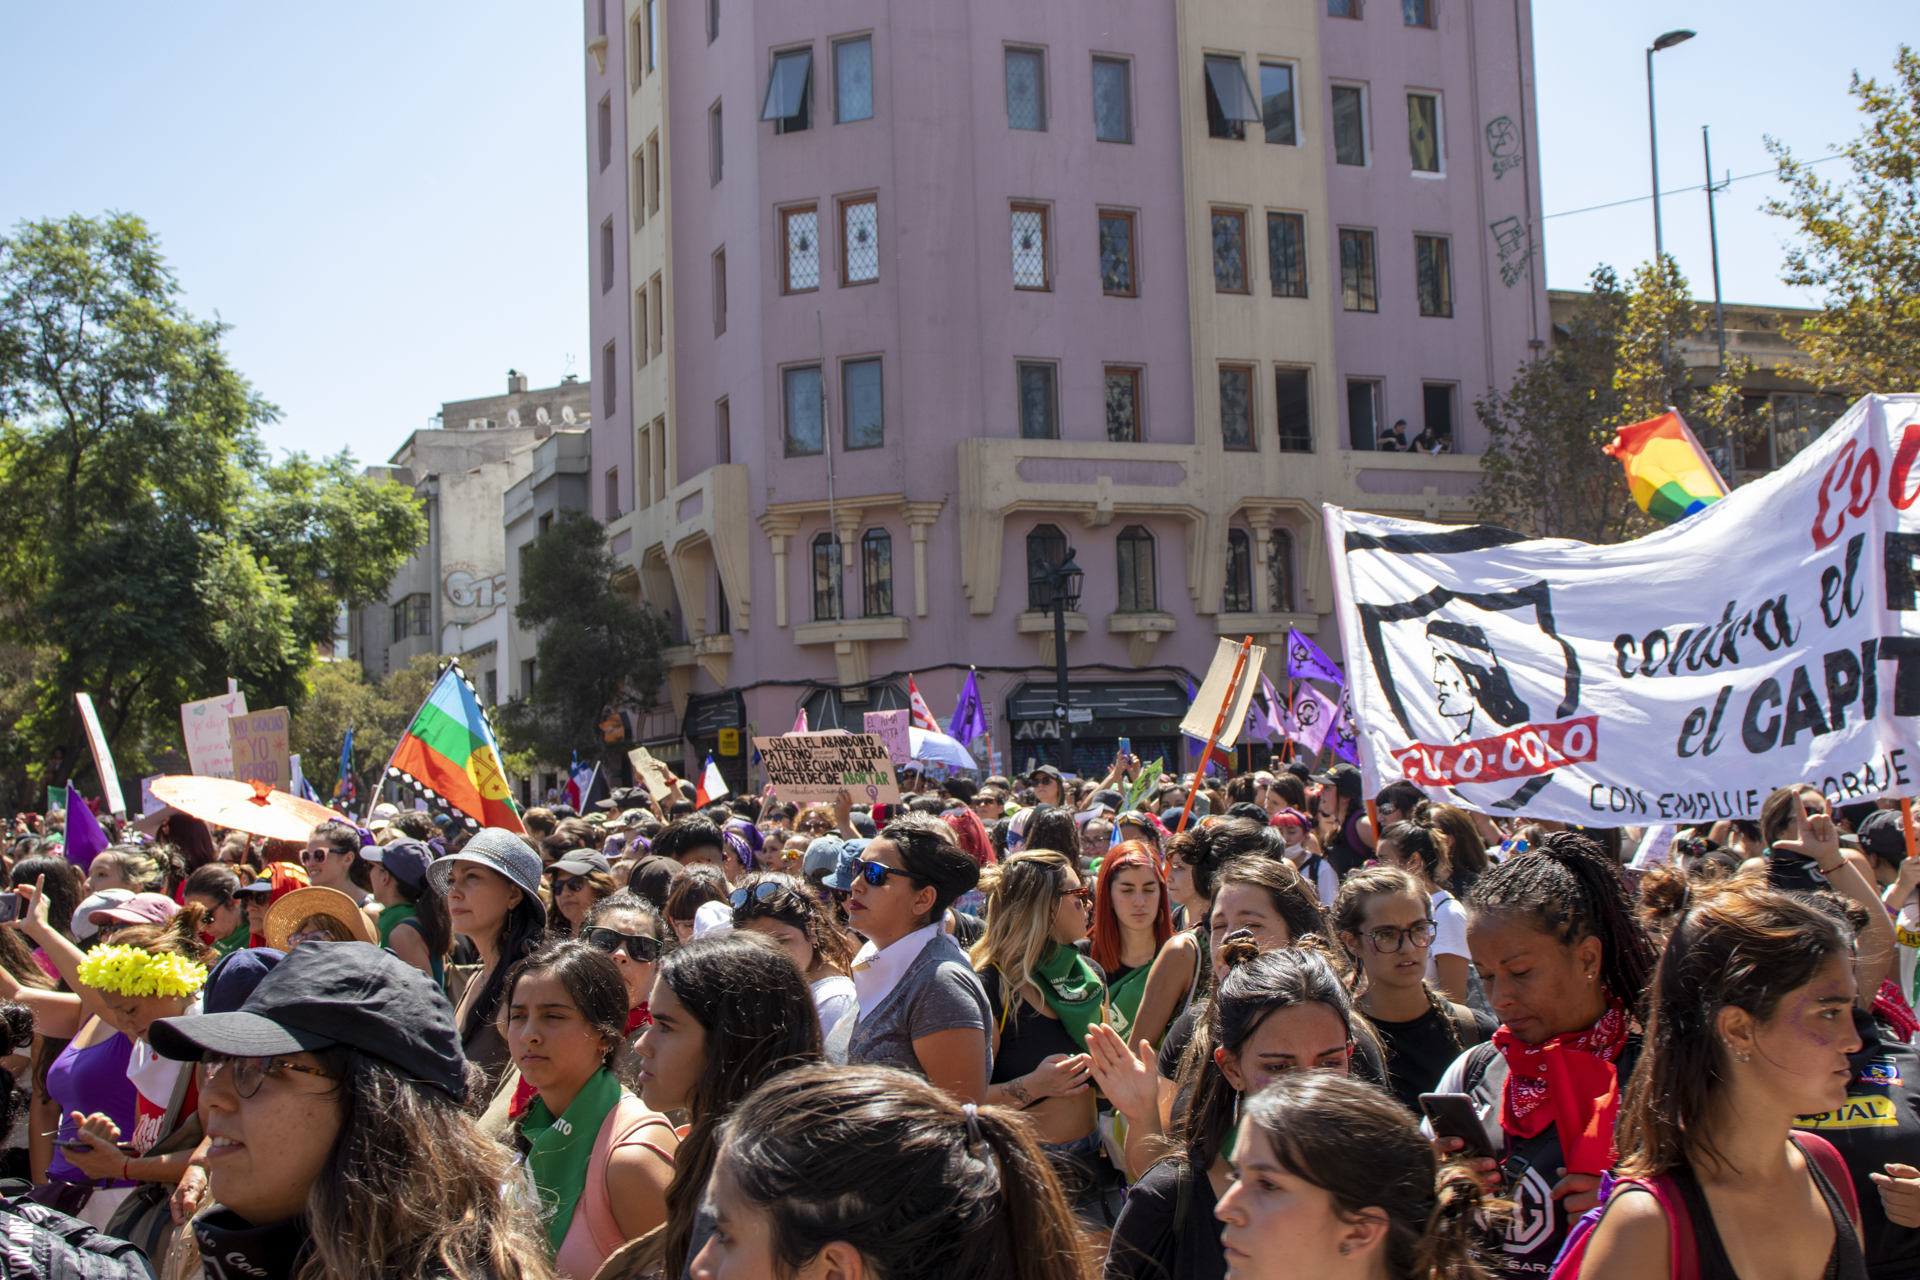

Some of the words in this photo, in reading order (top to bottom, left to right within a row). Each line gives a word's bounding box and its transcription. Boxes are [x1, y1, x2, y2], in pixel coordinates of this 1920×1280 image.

[1614, 594, 1802, 678] contra
[1820, 532, 1864, 628] el
[233, 720, 247, 736] NO
[251, 715, 284, 733] GRACIAS
[1677, 685, 1735, 758] el
[247, 736, 269, 761] YO
[760, 748, 812, 761] PATERNO
[839, 746, 888, 760] DOLIERA
[821, 735, 874, 749] ABANDONO
[851, 759, 877, 772] UNA
[842, 771, 890, 786] ABORTAR
[1589, 783, 1648, 815] CON
[1811, 748, 1911, 805] ORAJE
[8, 1245, 33, 1279] YOU
[225, 1251, 268, 1277] Colo
